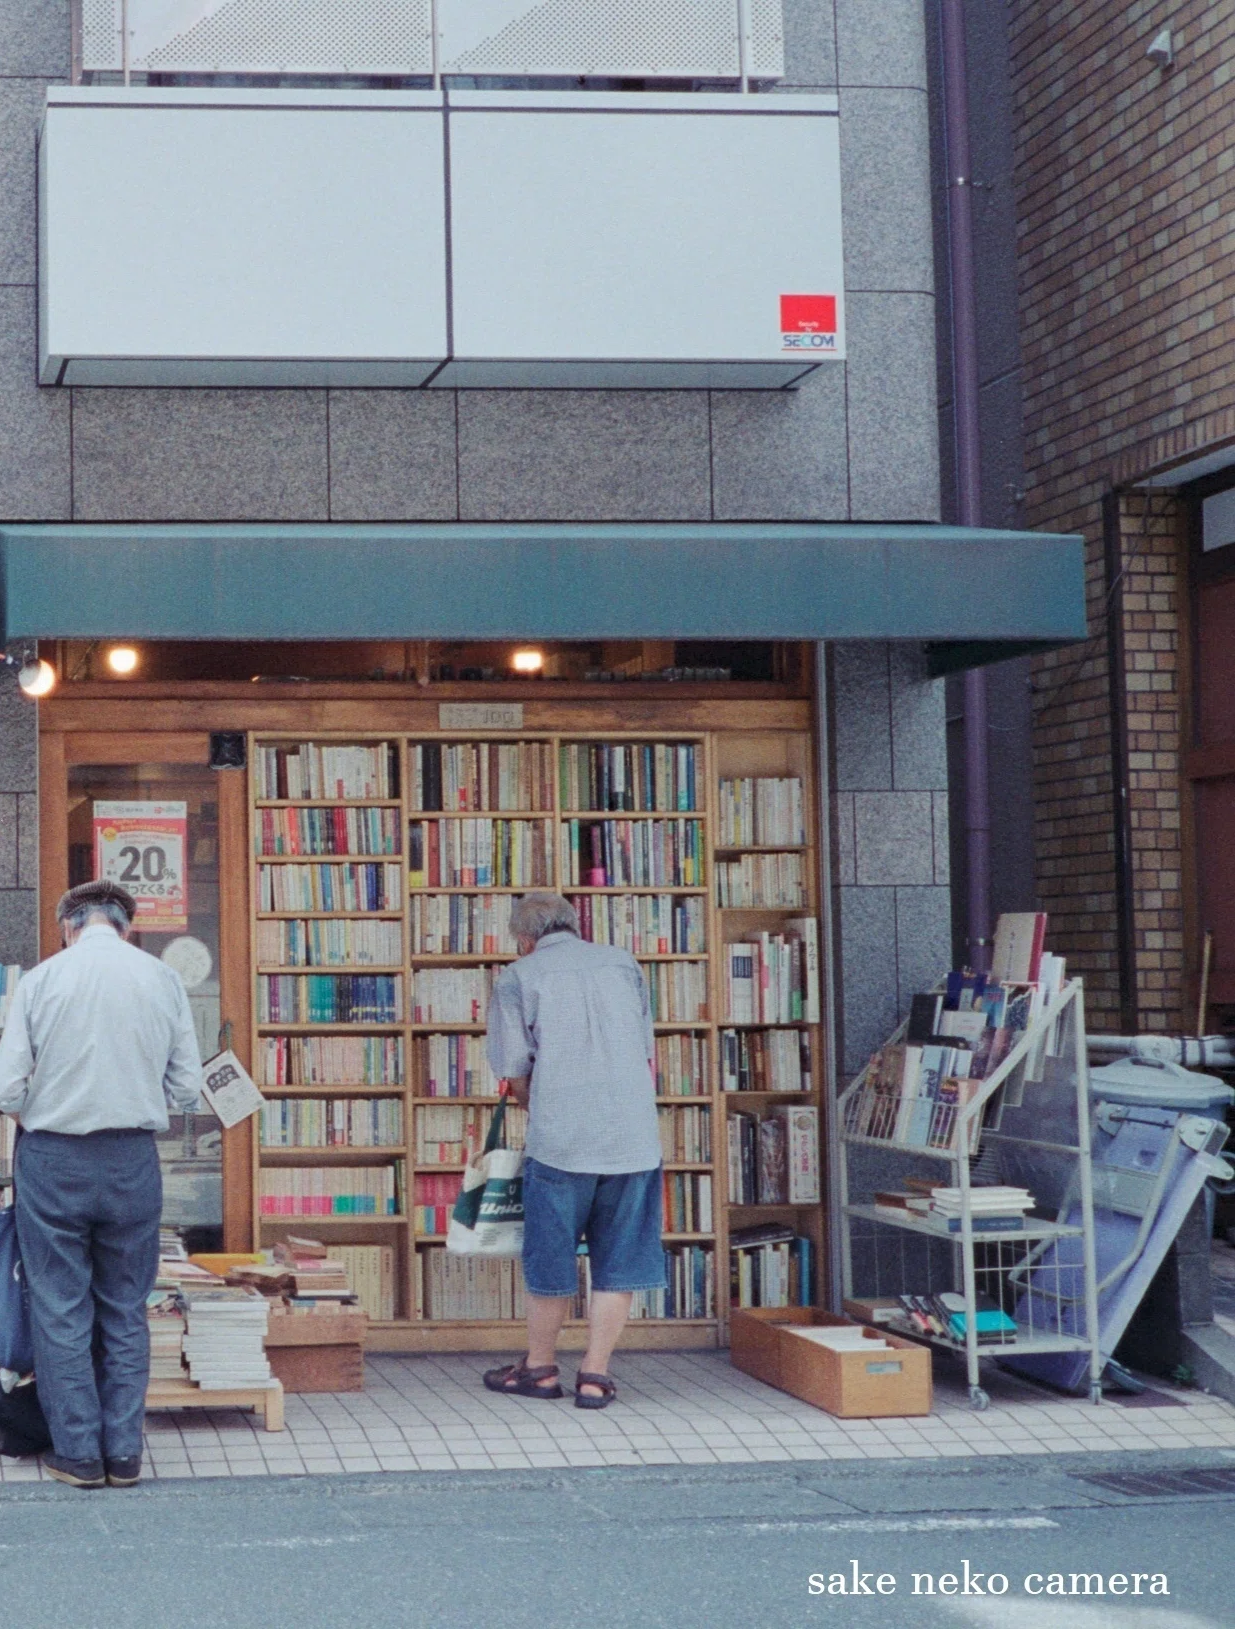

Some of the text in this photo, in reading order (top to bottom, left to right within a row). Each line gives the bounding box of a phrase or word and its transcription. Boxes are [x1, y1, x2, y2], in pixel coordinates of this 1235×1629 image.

[783, 334, 834, 347] SECOM
[119, 846, 177, 882] 20%
[480, 1200, 523, 1214] Unio
